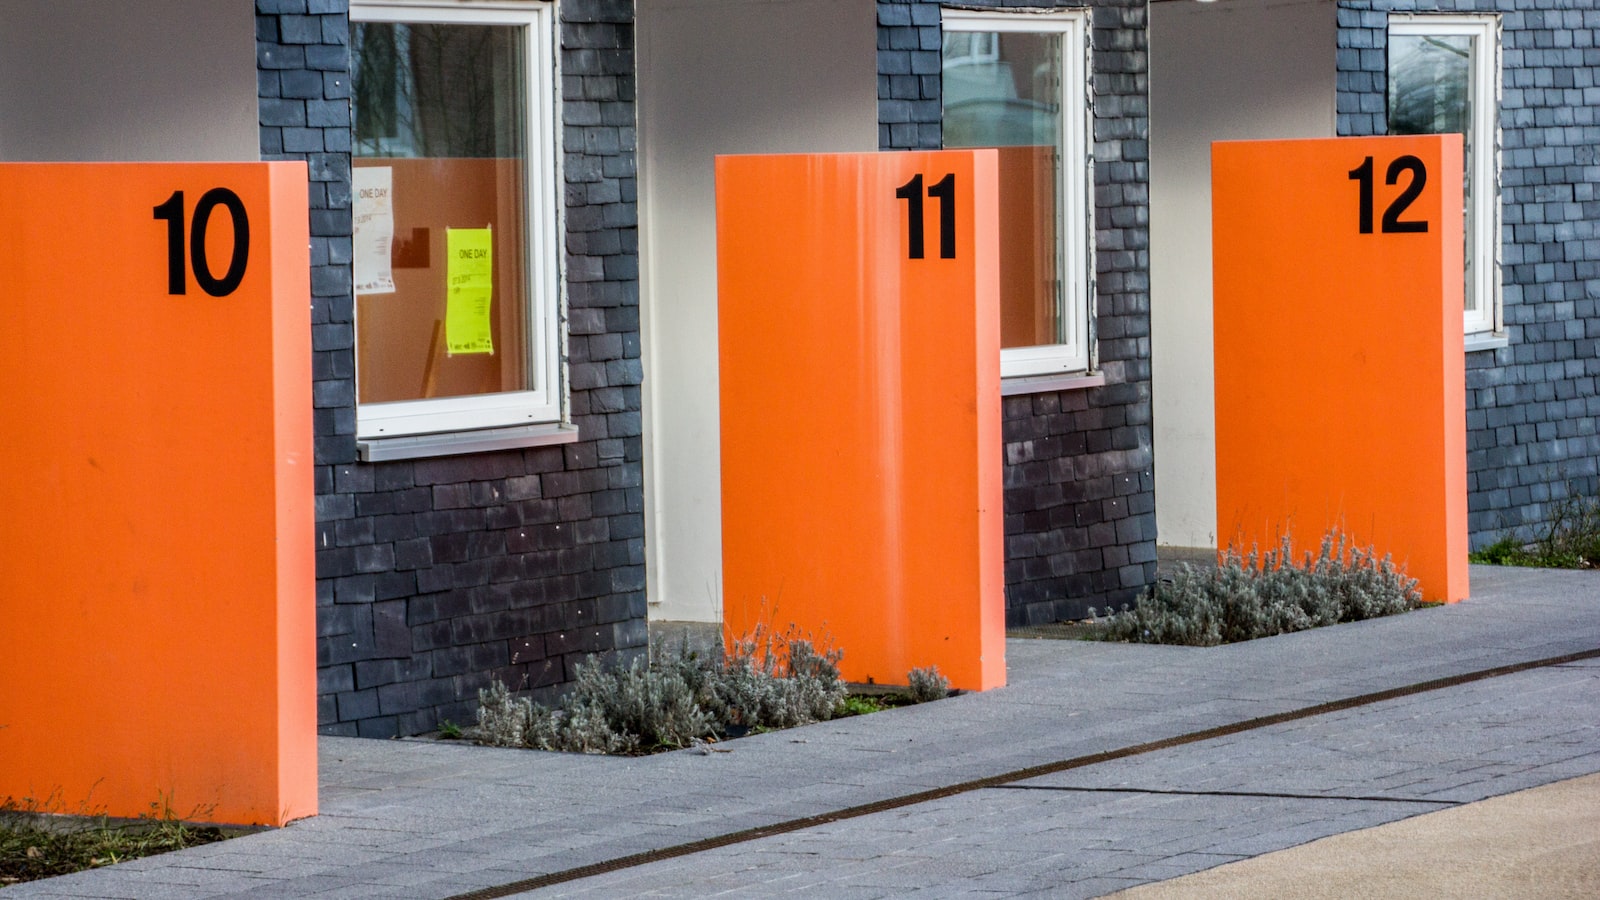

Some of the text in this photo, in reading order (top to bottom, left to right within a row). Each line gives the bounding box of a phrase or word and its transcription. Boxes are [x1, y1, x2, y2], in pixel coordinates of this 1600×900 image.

[359, 187, 388, 199] ONE DAY
[896, 174, 955, 259] 11
[1348, 155, 1428, 233] 12
[153, 187, 249, 297] 10
[459, 248, 487, 259] ONE DAY
